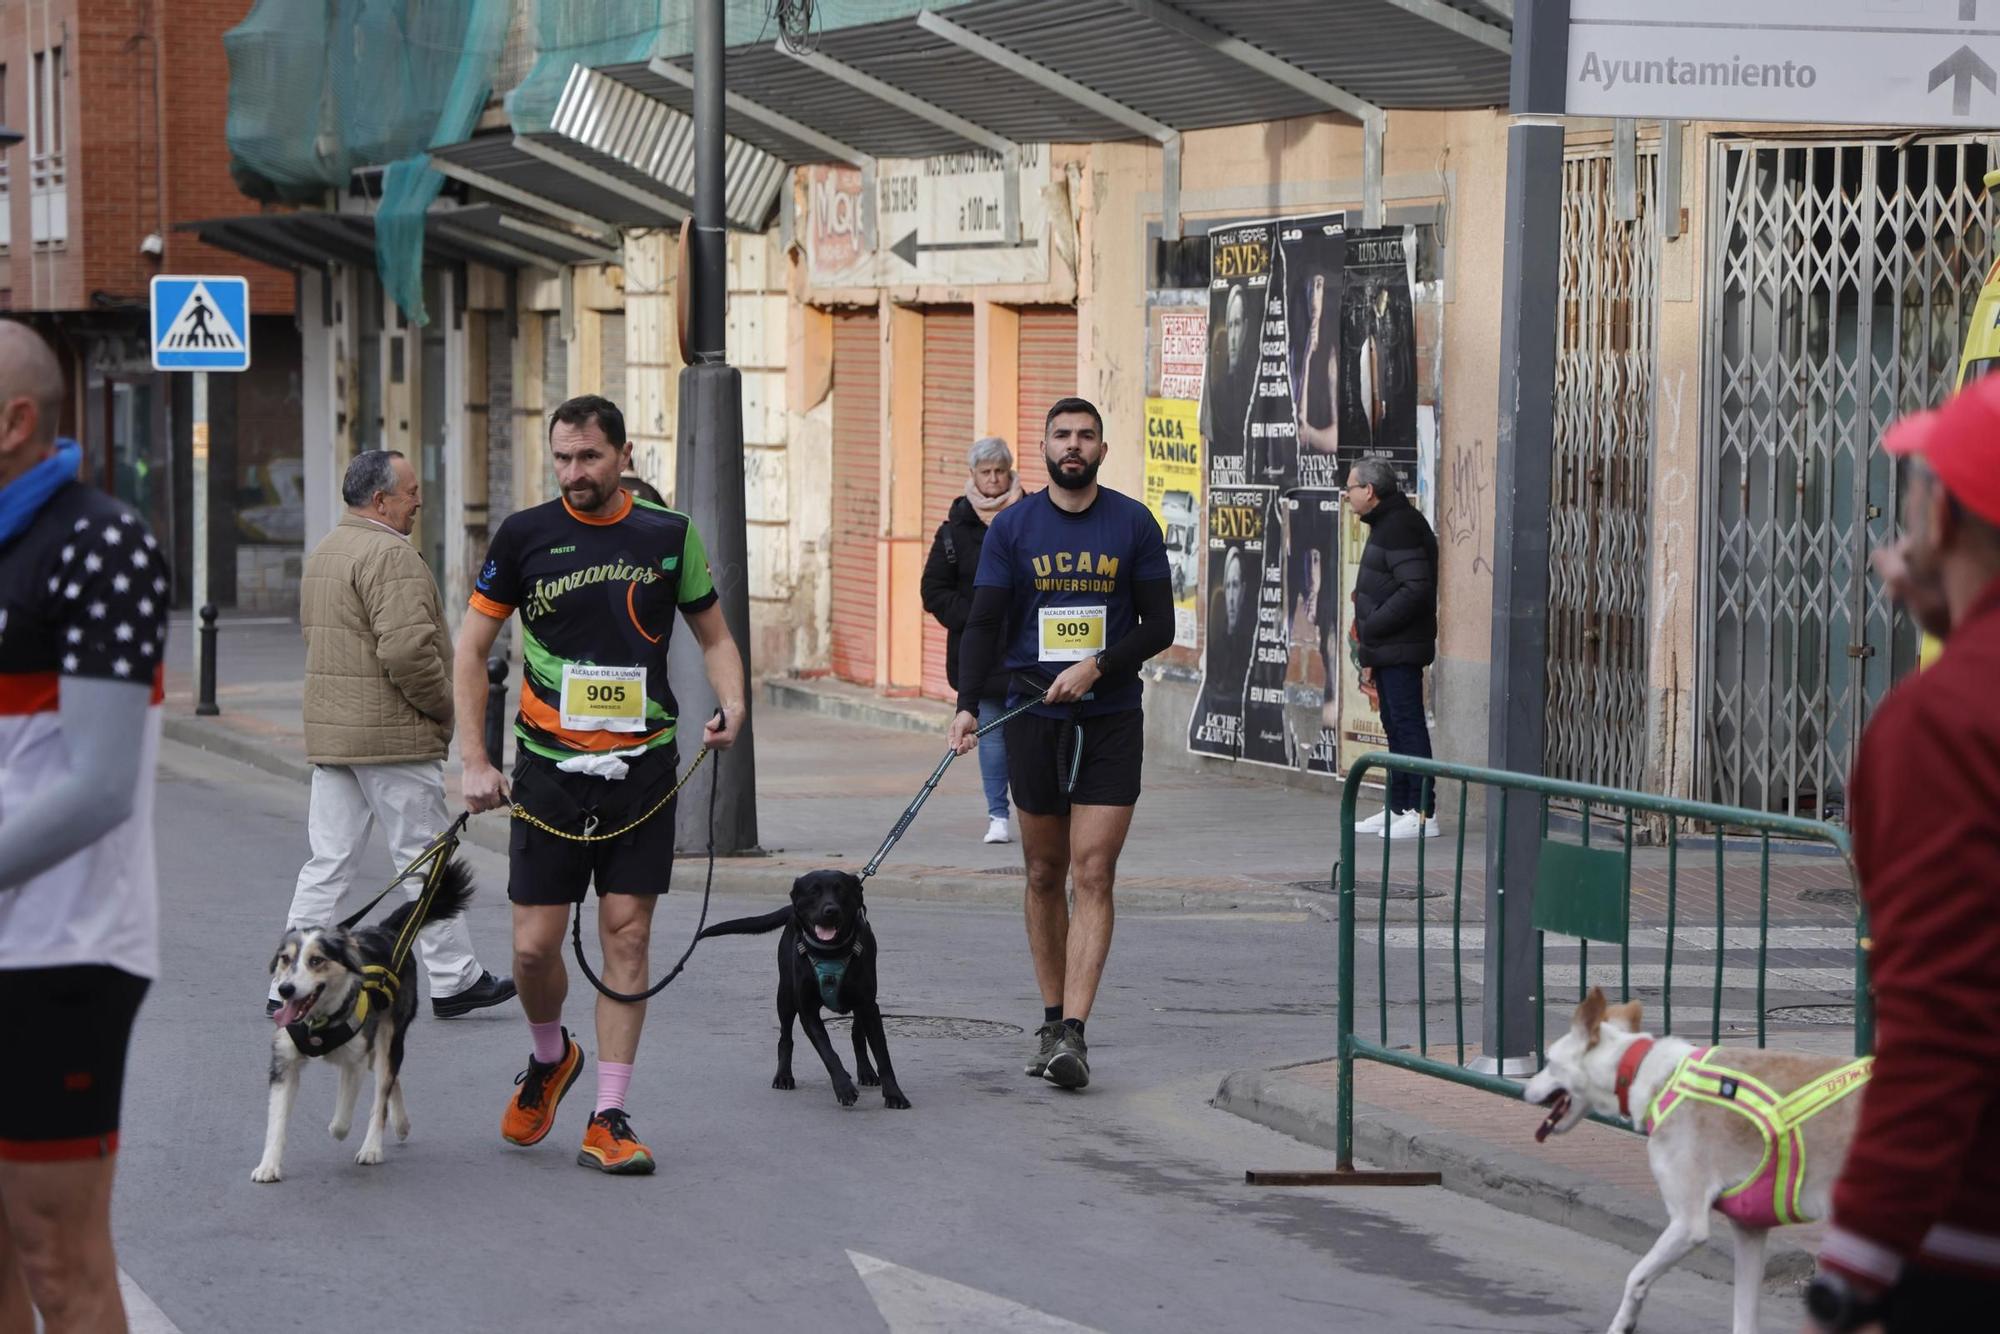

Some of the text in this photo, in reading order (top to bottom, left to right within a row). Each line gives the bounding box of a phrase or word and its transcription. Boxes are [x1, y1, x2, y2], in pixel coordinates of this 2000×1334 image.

[1578, 51, 1817, 91] Ayuntamiento
[968, 196, 983, 231] 100
[1221, 244, 1261, 276] EVE
[1148, 417, 1184, 440] CARA
[1149, 440, 1197, 464] VANING
[1217, 507, 1255, 537] EVE
[550, 545, 576, 555] FASTER
[1031, 552, 1119, 578] UCAM
[1035, 578, 1116, 592] UNIVERSIDAD
[1057, 622, 1090, 636] 909
[571, 668, 599, 677] ALCALDE
[621, 670, 641, 678] UNIÓN
[587, 685, 626, 702] 905
